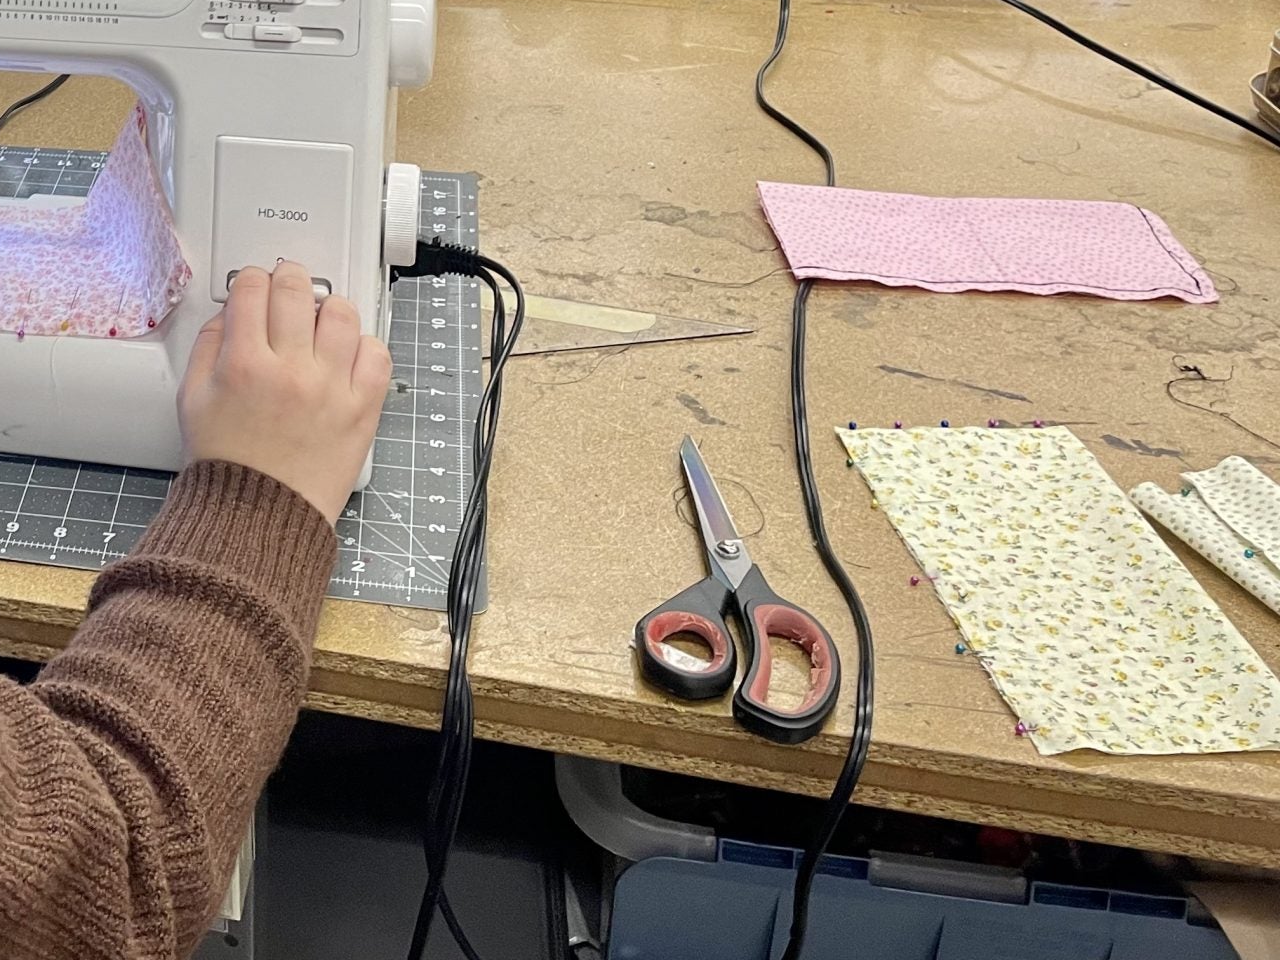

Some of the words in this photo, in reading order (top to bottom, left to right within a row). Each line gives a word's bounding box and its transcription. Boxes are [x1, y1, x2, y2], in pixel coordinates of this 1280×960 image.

[433, 190, 447, 199] 17
[258, 208, 308, 222] HD-3000
[433, 206, 447, 216] 16
[433, 223, 447, 233] 15
[431, 277, 446, 289] 12
[431, 297, 446, 308] 11
[431, 317, 446, 329] 10
[430, 364, 446, 372] 8
[430, 388, 446, 396] 7
[430, 413, 446, 422] 6
[429, 440, 445, 448] 5
[428, 467, 446, 476] 4
[428, 495, 446, 504] 3
[428, 523, 446, 533] 2
[5, 521, 20, 533] 9
[53, 526, 67, 538] 8
[103, 531, 117, 543] 7
[351, 560, 366, 573] 2
[404, 566, 416, 578] 1
[427, 554, 446, 562] 1
